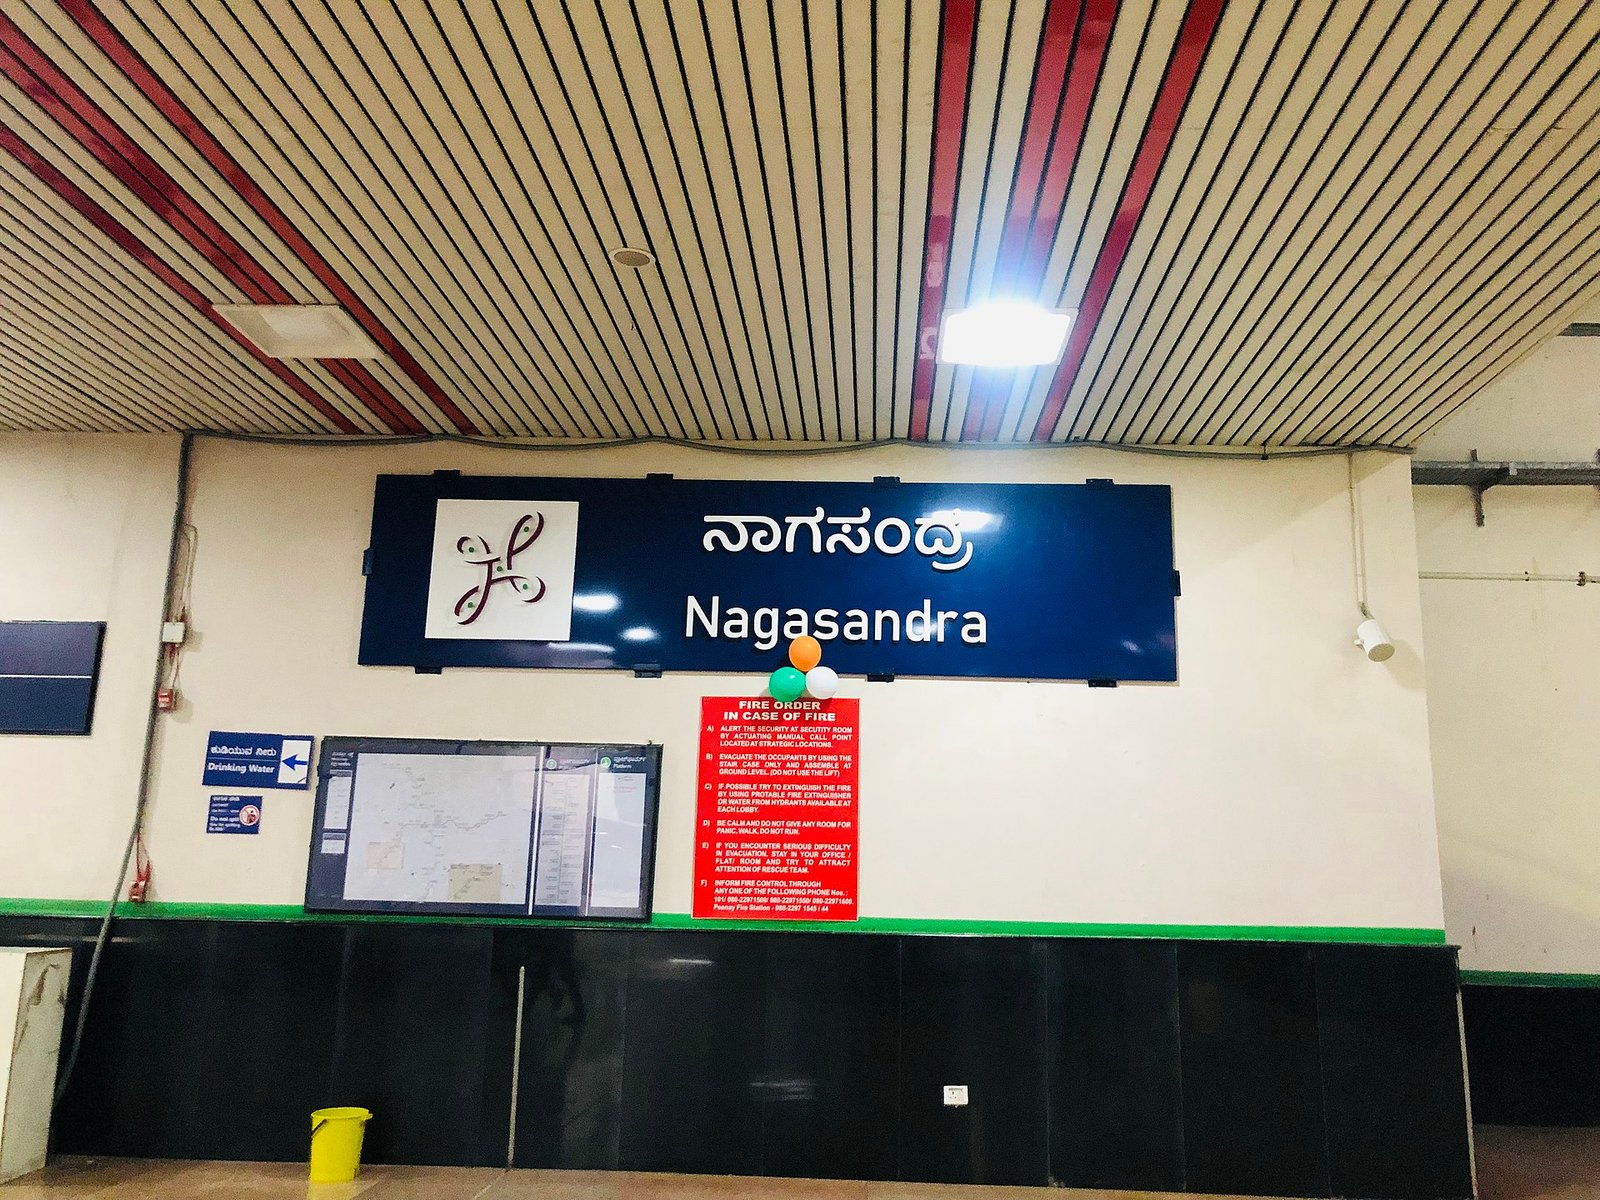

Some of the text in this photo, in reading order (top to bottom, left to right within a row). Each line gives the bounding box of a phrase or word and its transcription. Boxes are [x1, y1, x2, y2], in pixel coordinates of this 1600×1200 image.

[703, 506, 973, 570] ನಾಗಸಂದ್ರ
[686, 596, 987, 650] Nagasandra
[208, 763, 275, 774] Drinking Water
